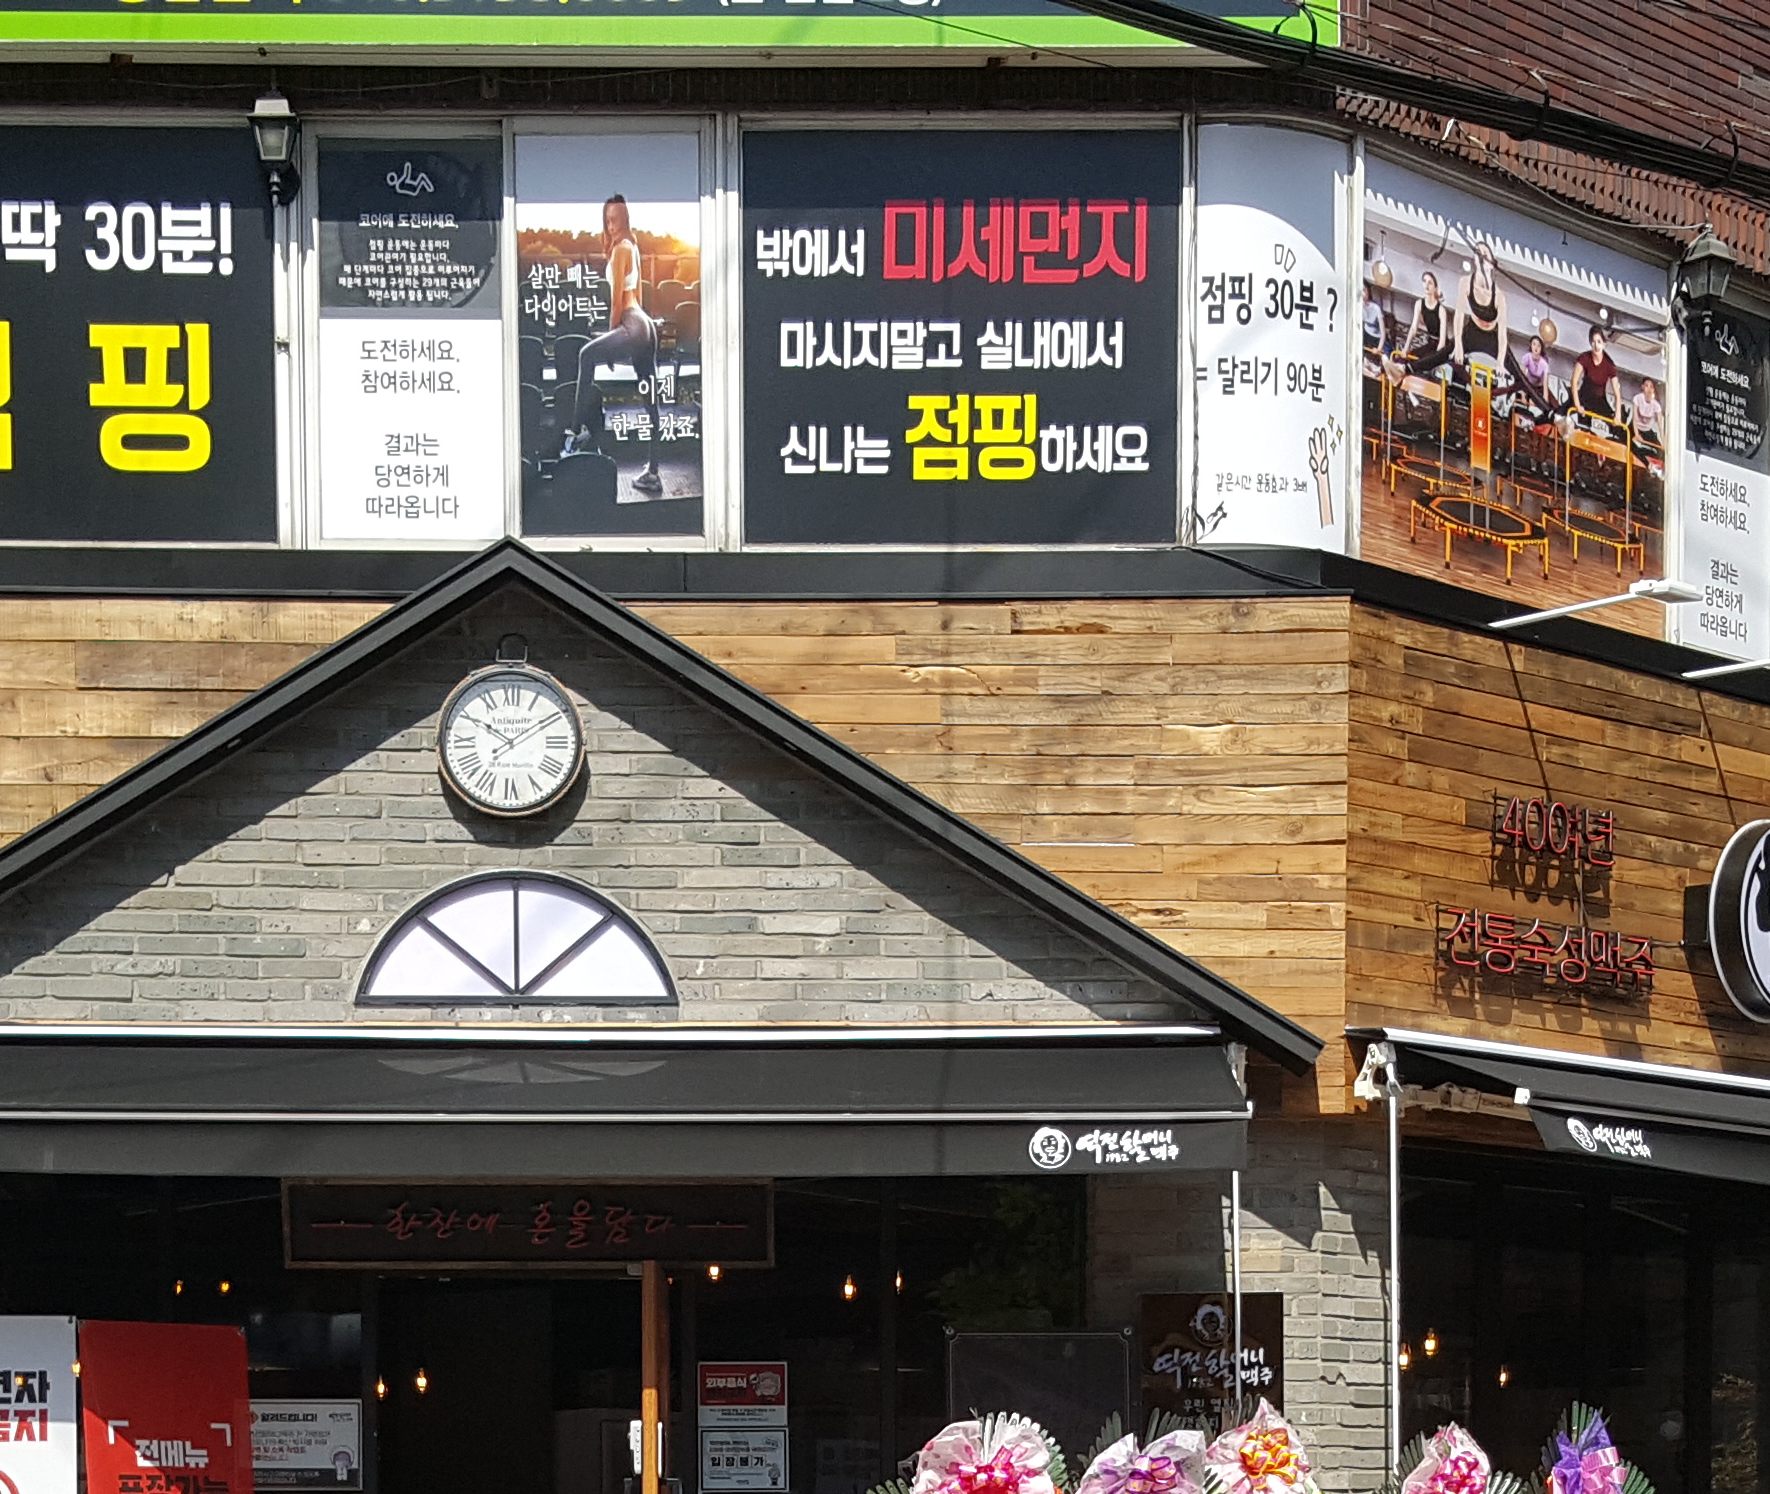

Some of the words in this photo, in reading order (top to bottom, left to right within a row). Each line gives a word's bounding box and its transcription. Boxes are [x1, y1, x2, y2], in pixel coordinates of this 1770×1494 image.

[1, 199, 61, 275] 딱
[84, 201, 234, 277] 30분!
[755, 225, 865, 279] 밖에서
[882, 196, 1149, 284] 미세먼지
[527, 264, 562, 289] 살만
[567, 264, 600, 289] 빼는
[1200, 273, 1253, 325] 점핑
[1265, 279, 1318, 330] 30분
[1327, 287, 1338, 332] ?
[360, 340, 460, 364] 도전하세요.
[780, 319, 962, 370] 마시지말고
[977, 319, 1123, 370] 실내에서
[360, 370, 460, 395] 참여하세요.
[638, 375, 676, 404] 이젠
[1216, 357, 1279, 396] 달리기
[1286, 362, 1326, 402] 90분
[384, 433, 440, 458] 결과는
[780, 424, 890, 475] 신나는
[374, 465, 449, 488] 당연하게
[1699, 474, 1750, 507] 도전하세요.
[365, 495, 459, 519] 따라옵니다
[1699, 500, 1750, 534] 참여하세요.
[1710, 559, 1739, 585] 결과는
[1705, 585, 1743, 615] 당연하게
[1700, 614, 1747, 643] 따라옵니다
[384, 1201, 500, 1241] 한잔에
[135, 1438, 208, 1469] 전메뉴
